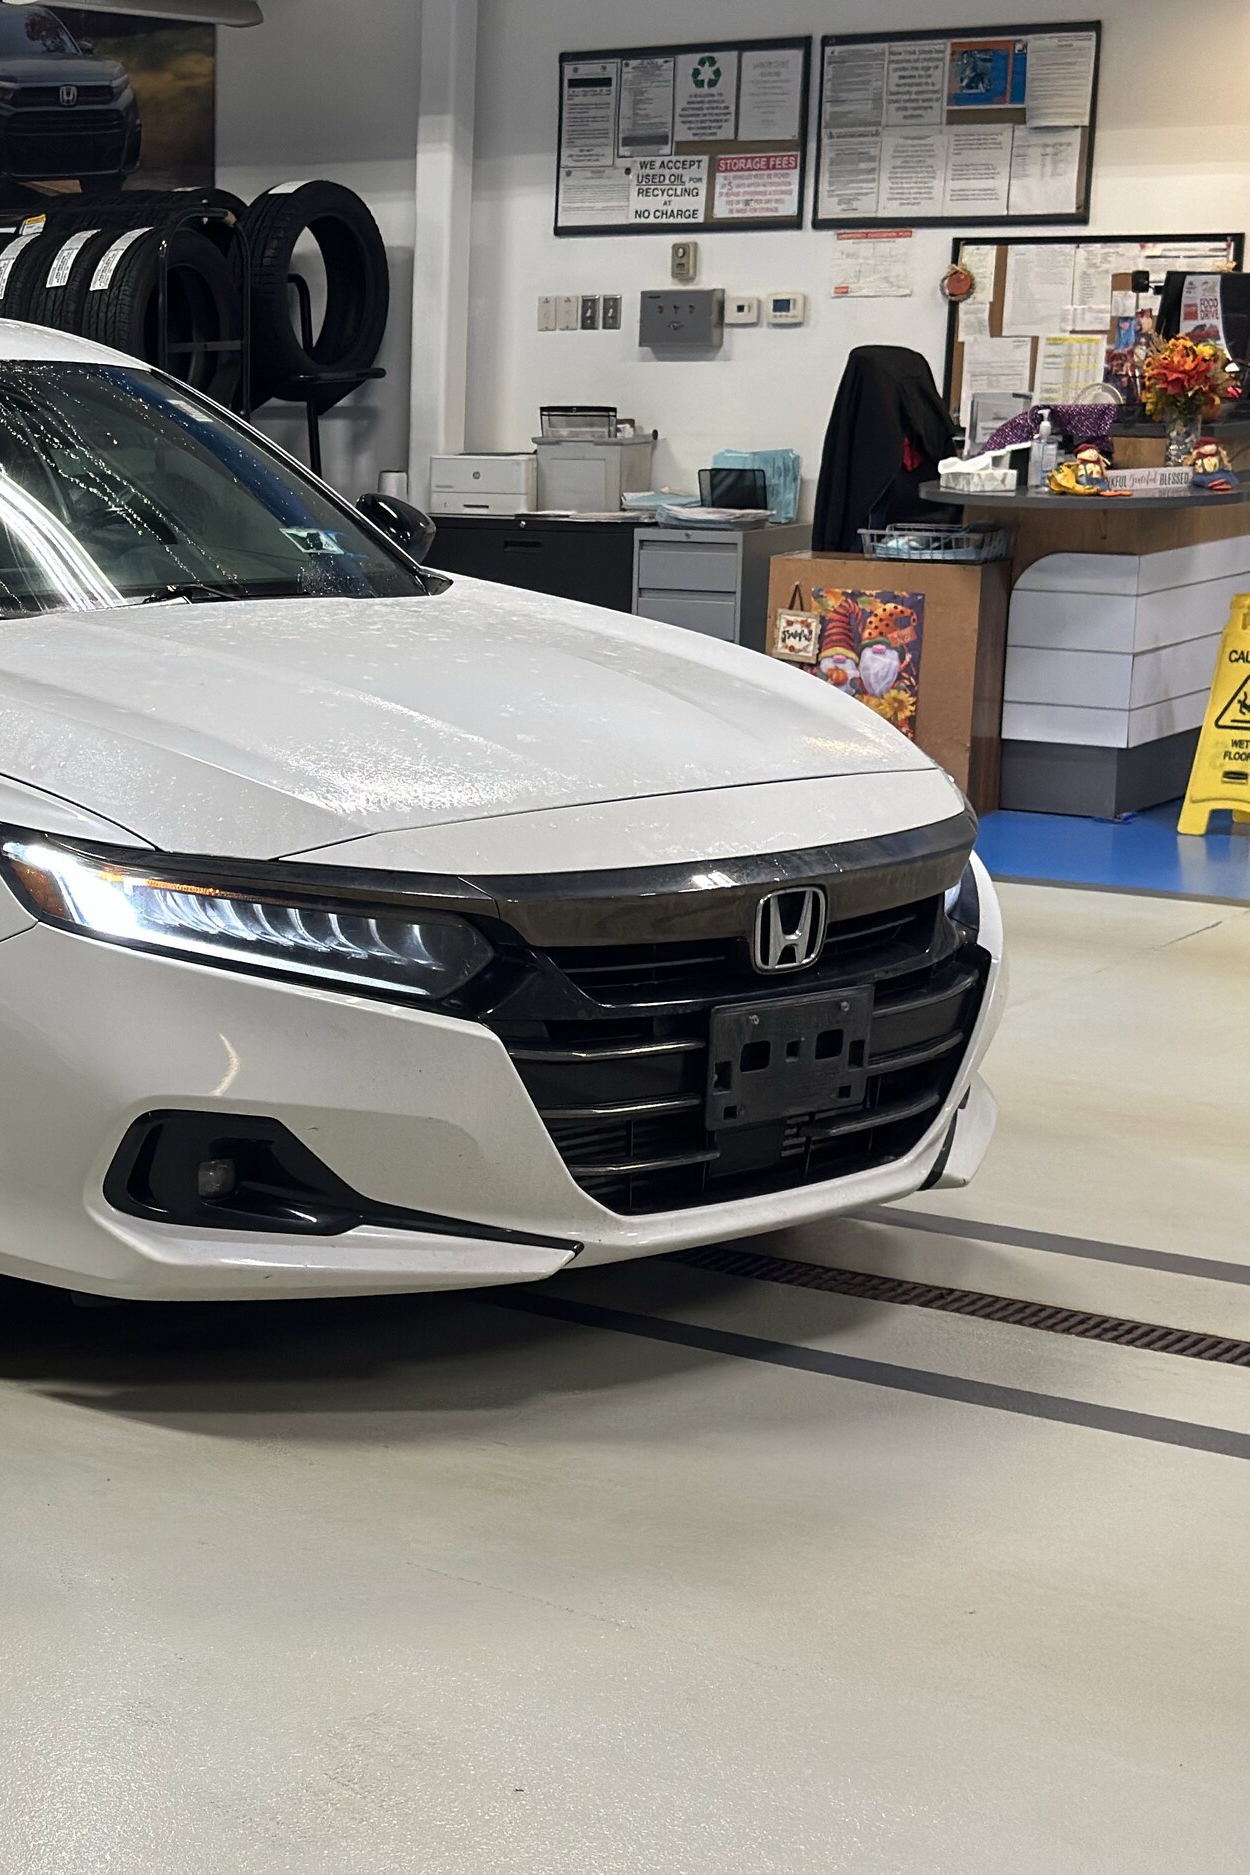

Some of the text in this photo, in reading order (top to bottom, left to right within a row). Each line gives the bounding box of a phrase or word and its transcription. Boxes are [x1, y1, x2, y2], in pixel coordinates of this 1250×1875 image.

[639, 159, 703, 170] WE ACCEPT
[718, 156, 796, 171] STORAGE FEES
[636, 173, 666, 185] USED
[668, 173, 686, 184] OIL
[637, 187, 699, 198] RECYCLING
[634, 208, 699, 220] NO CHARGE
[1200, 297, 1219, 309] FOOD
[1200, 309, 1219, 321] DRIVE
[1230, 738, 1250, 749] WET
